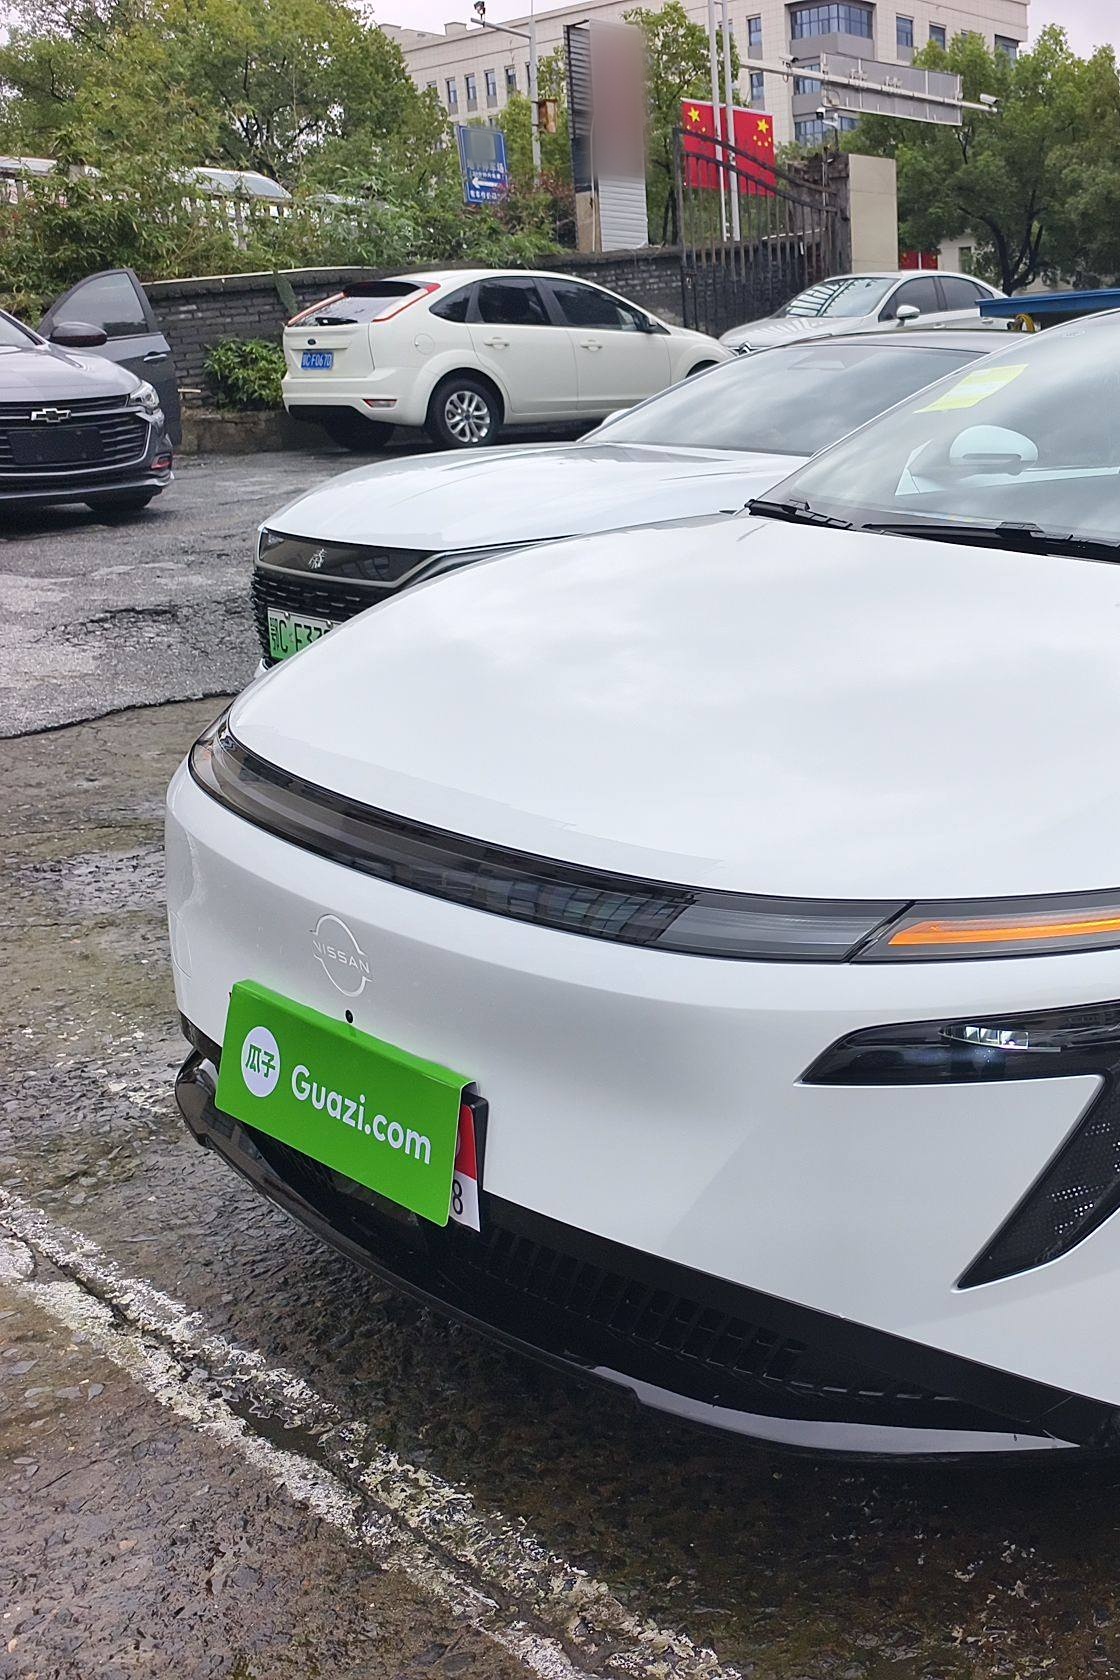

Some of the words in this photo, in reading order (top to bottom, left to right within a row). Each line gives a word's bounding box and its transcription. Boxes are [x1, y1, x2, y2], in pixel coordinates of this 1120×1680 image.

[312, 940, 370, 974] NISSAN
[245, 1043, 276, 1079] 瓜子
[291, 1064, 433, 1166] Guazi.com
